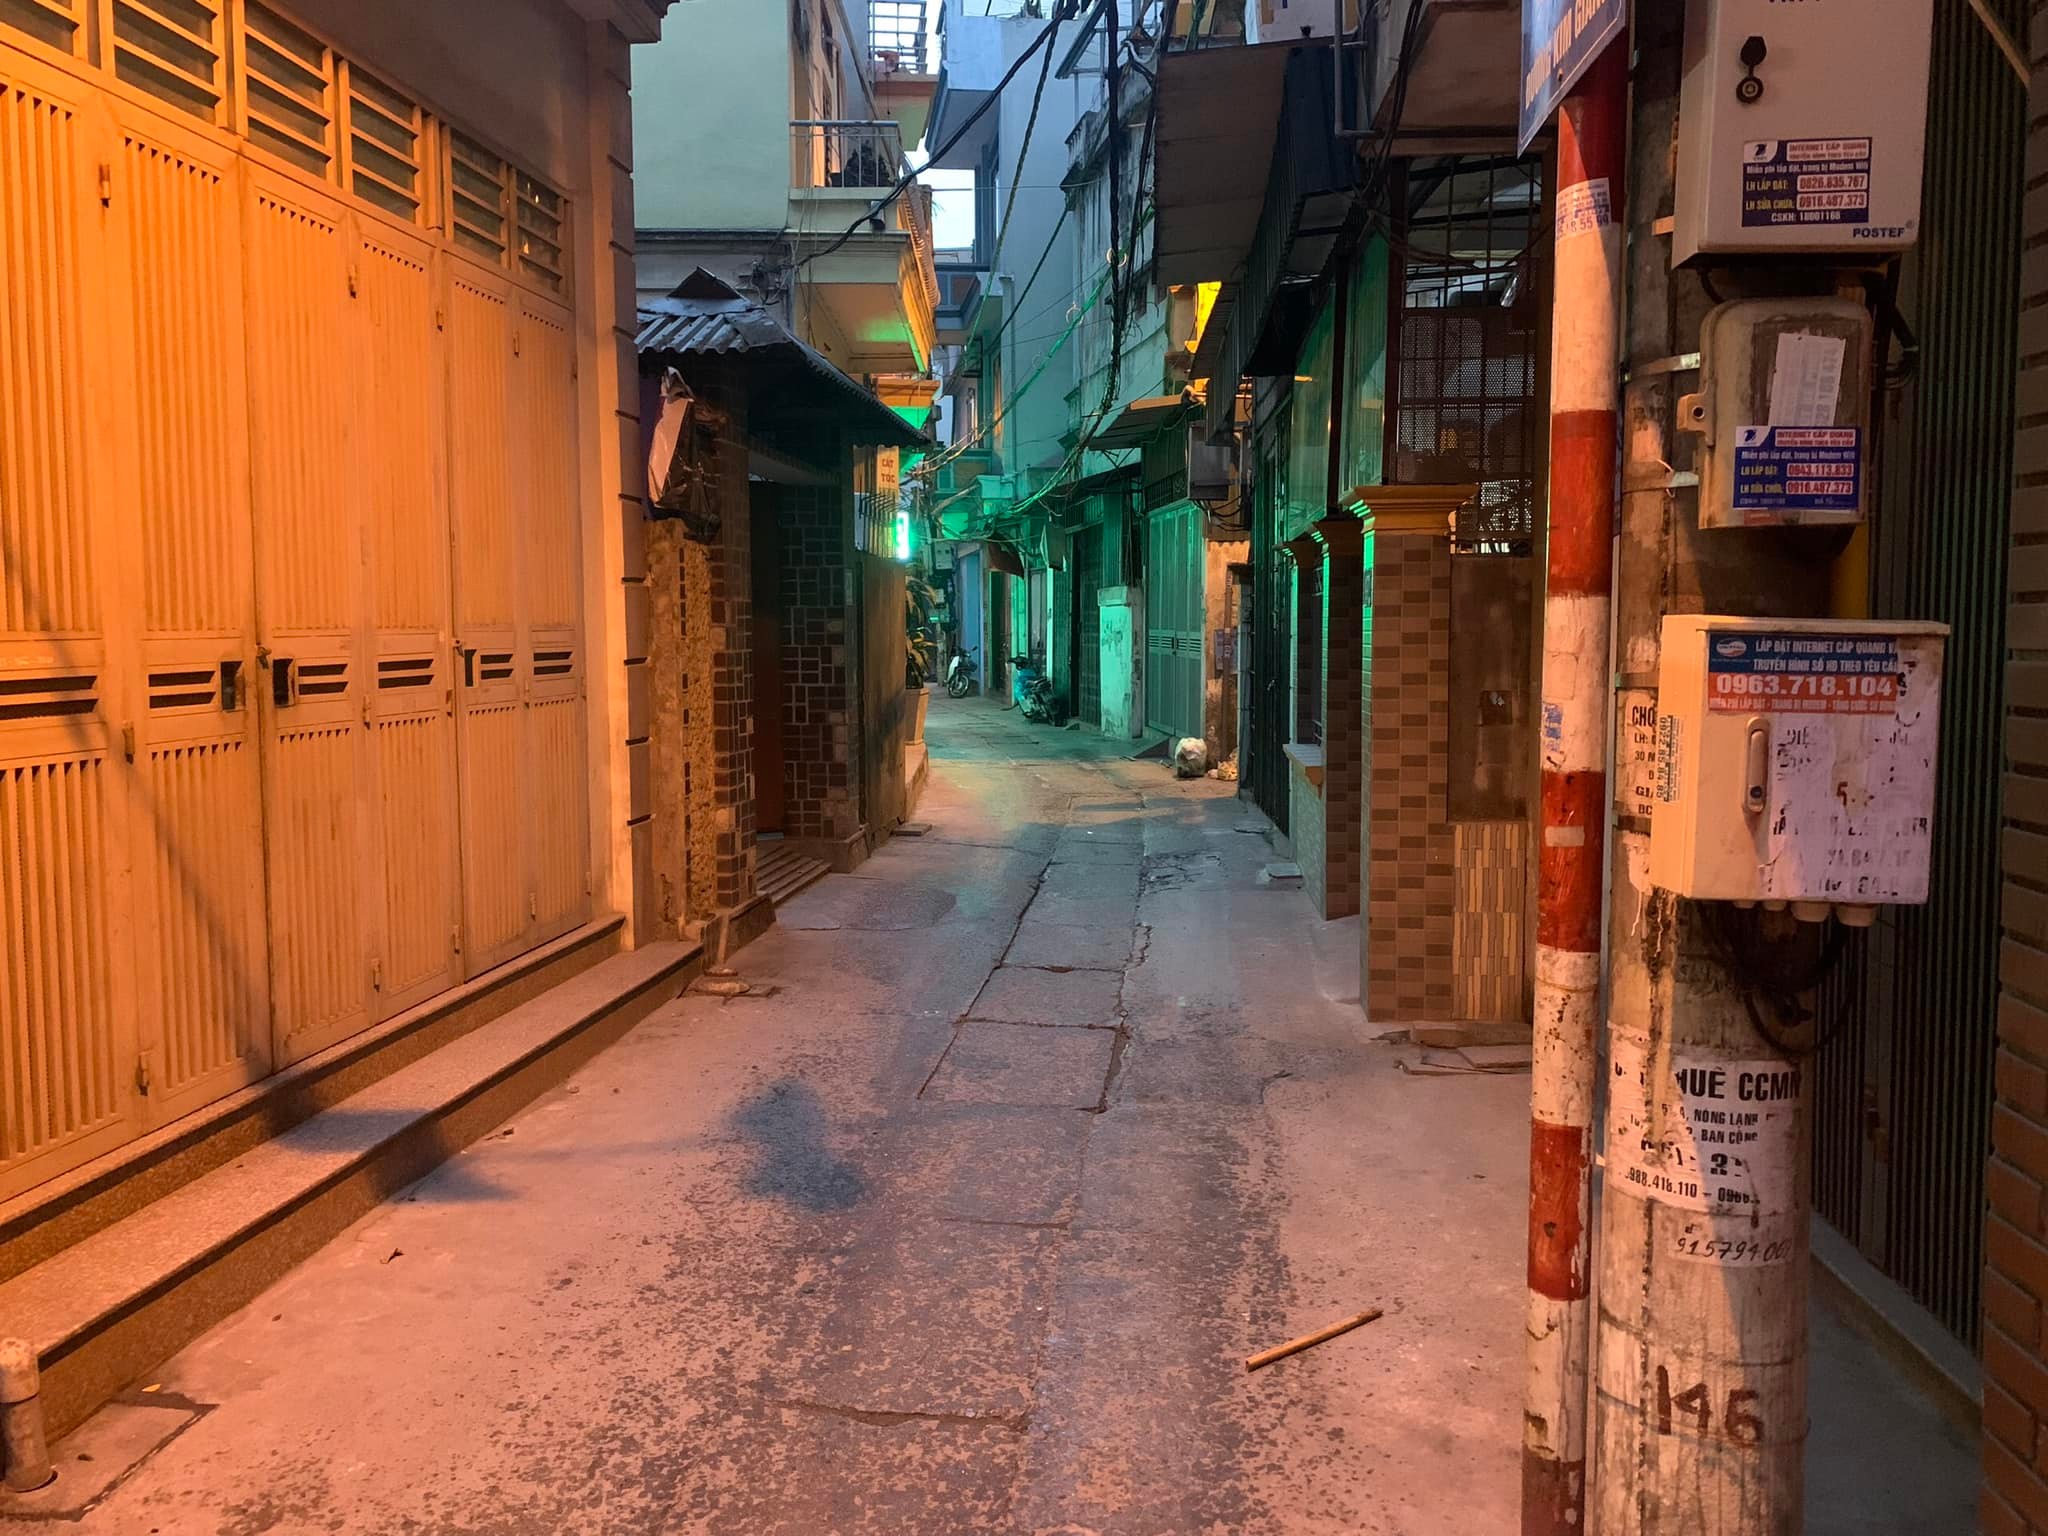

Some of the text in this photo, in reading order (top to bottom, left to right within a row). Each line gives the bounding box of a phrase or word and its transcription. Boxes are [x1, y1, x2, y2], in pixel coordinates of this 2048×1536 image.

[1553, 7, 1572, 68] KIM
[1746, 181, 1755, 191] LH
[1746, 199, 1755, 209] LH
[1853, 227, 1905, 239] POSTEF
[1793, 640, 1834, 653] INTERNET
[1856, 641, 1886, 654] QUANG
[1840, 660, 1862, 672] THEO
[1864, 657, 1880, 672] YÊU
[1716, 674, 1893, 696] 0963.718.104
[1634, 733, 1648, 744] LH:
[1634, 750, 1645, 761] 30
[1693, 1107, 1726, 1125] NÓNG
[1701, 1129, 1725, 1144] BAN
